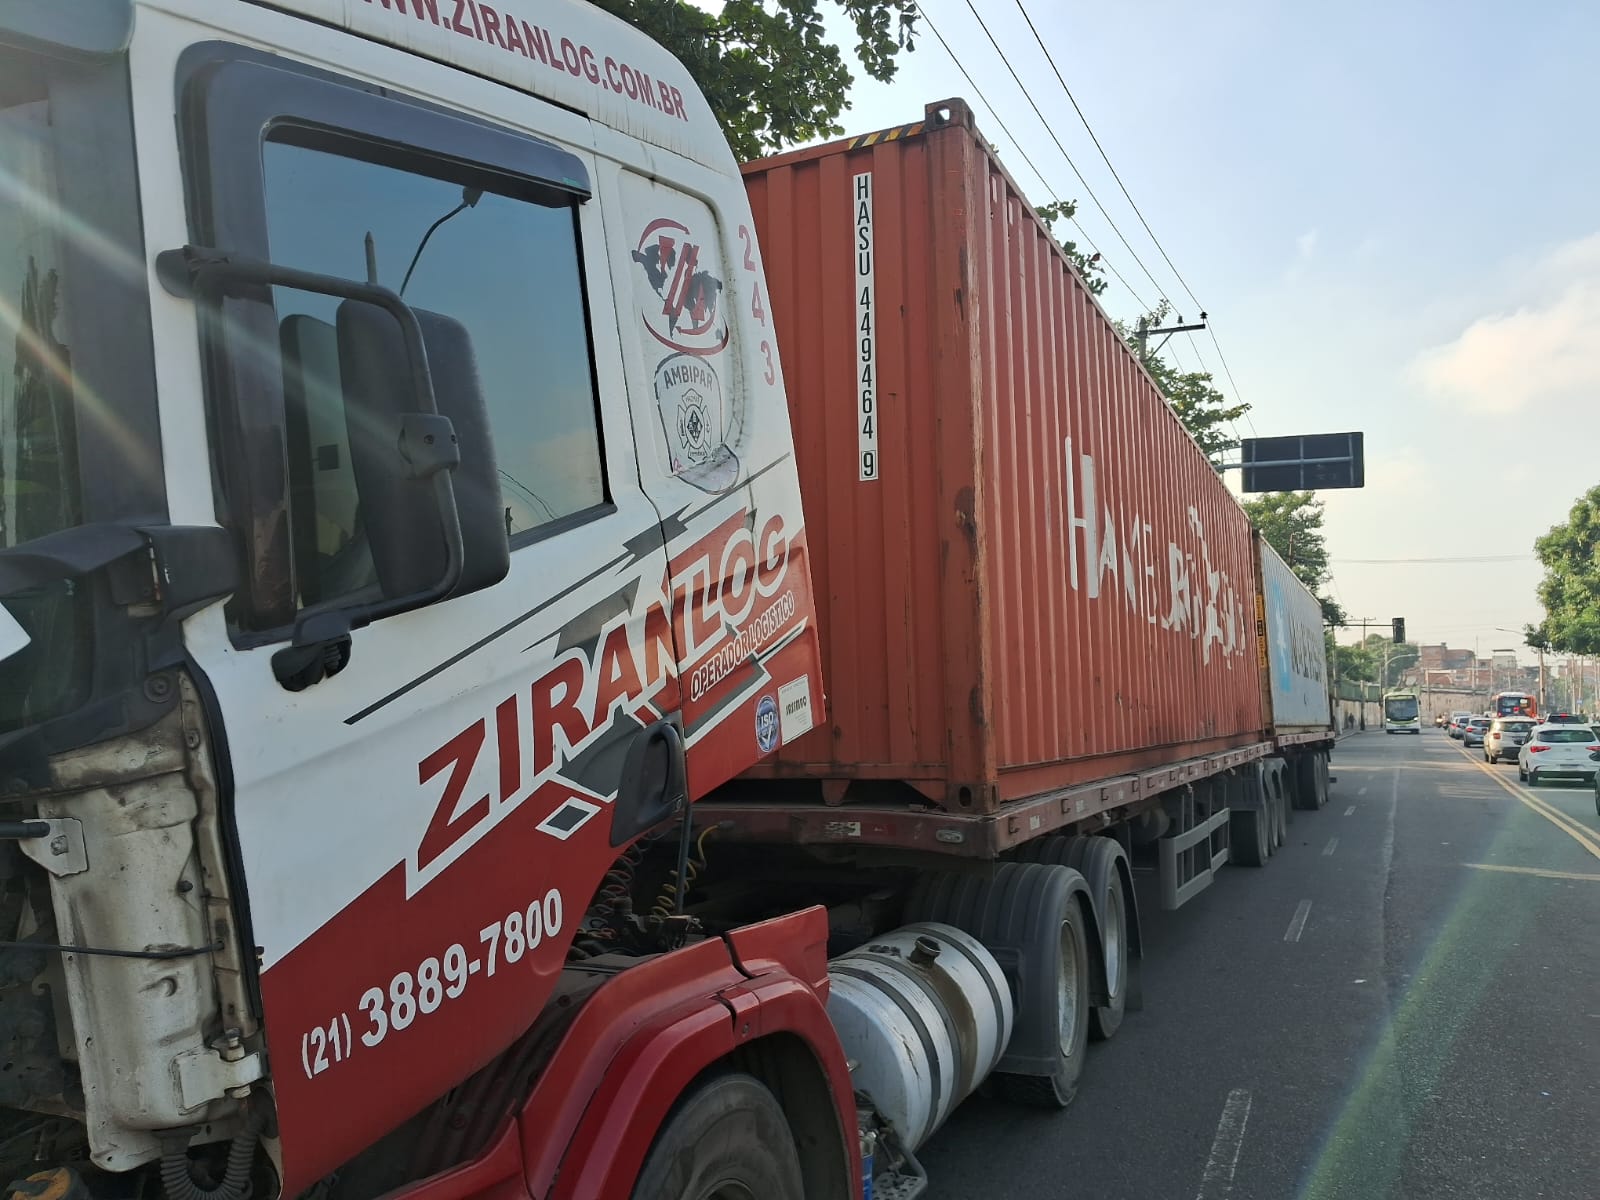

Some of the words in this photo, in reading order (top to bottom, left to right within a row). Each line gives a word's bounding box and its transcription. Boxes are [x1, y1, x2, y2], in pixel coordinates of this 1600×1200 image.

[362, 0, 689, 122] W.ZIRANLOG.COM.BR
[857, 176, 871, 276] HASU
[663, 365, 712, 391] AMBIPAR
[859, 286, 874, 440] 449464
[863, 451, 874, 477] 9
[415, 512, 791, 878] ZIRANLOG
[690, 630, 750, 702] OPERADOR
[761, 711, 774, 729] ISO
[302, 1012, 351, 1080] (21)
[358, 888, 563, 1047] 3889-7800
